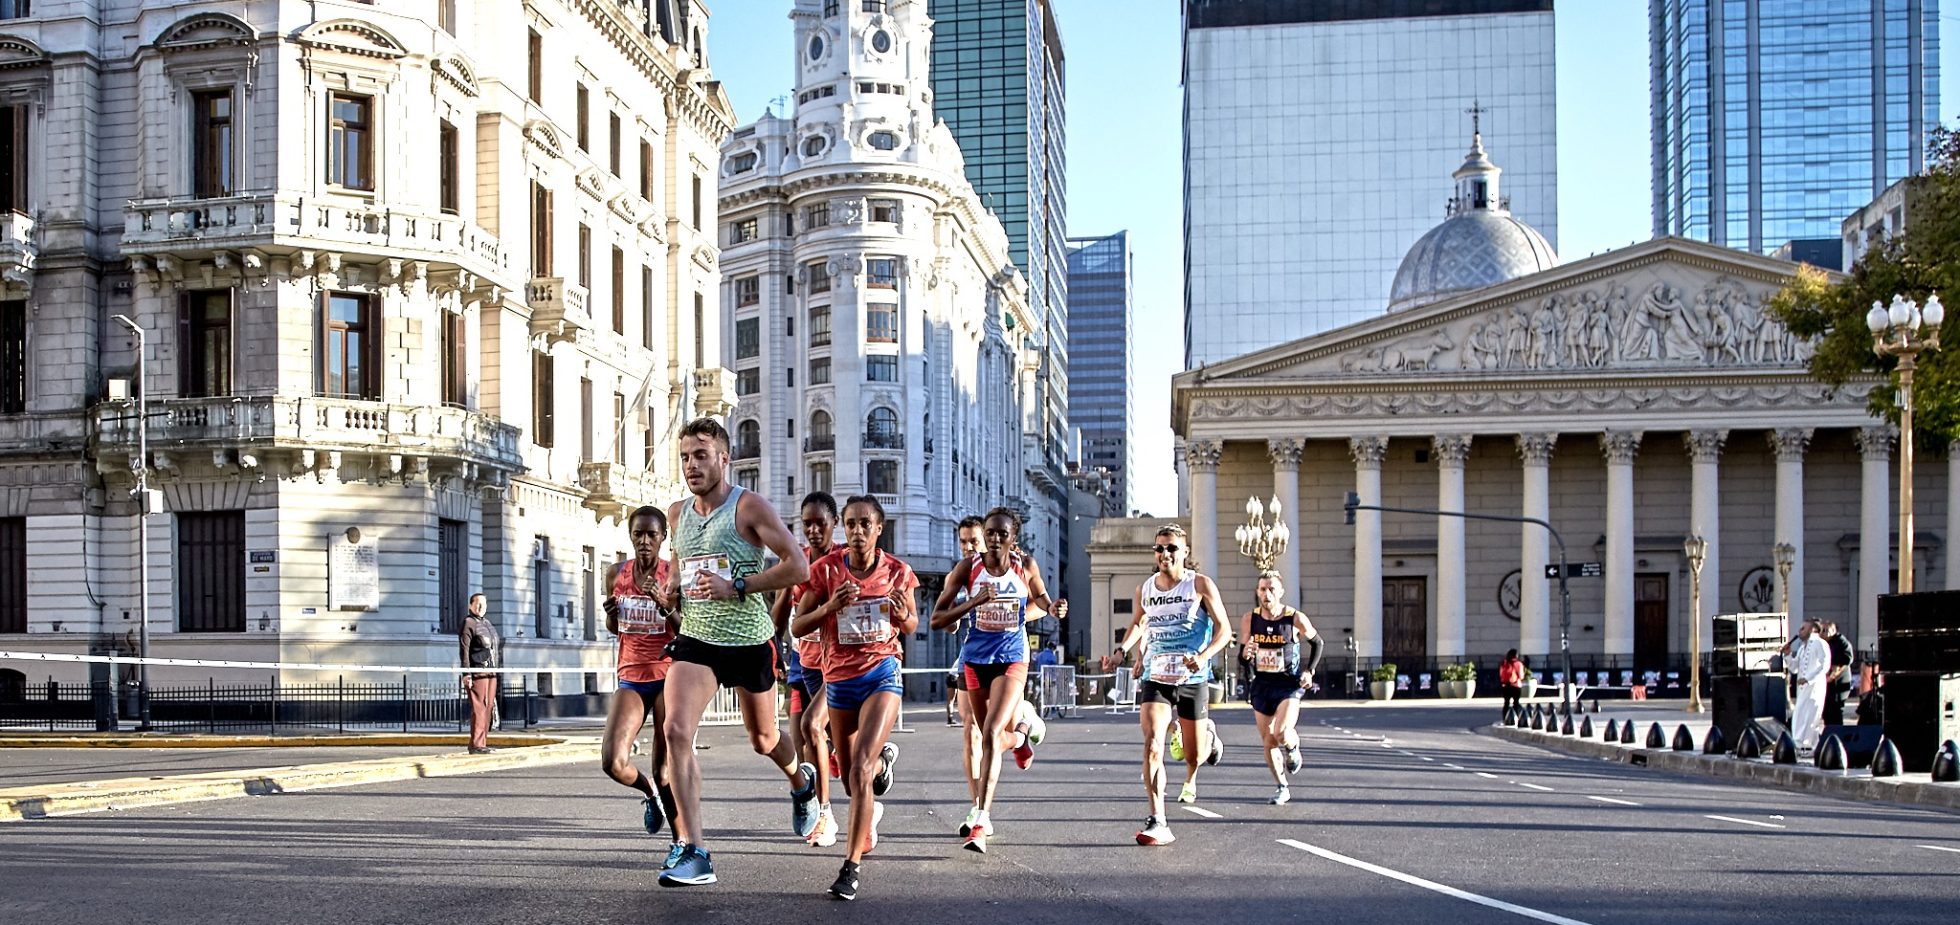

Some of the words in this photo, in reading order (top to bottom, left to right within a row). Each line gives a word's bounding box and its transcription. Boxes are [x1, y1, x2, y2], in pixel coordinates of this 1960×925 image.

[624, 607, 657, 622] TANUI
[855, 615, 872, 630] 71
[1254, 634, 1286, 644] BRASIL
[1260, 656, 1276, 665] 414
[1164, 663, 1176, 674] 41
